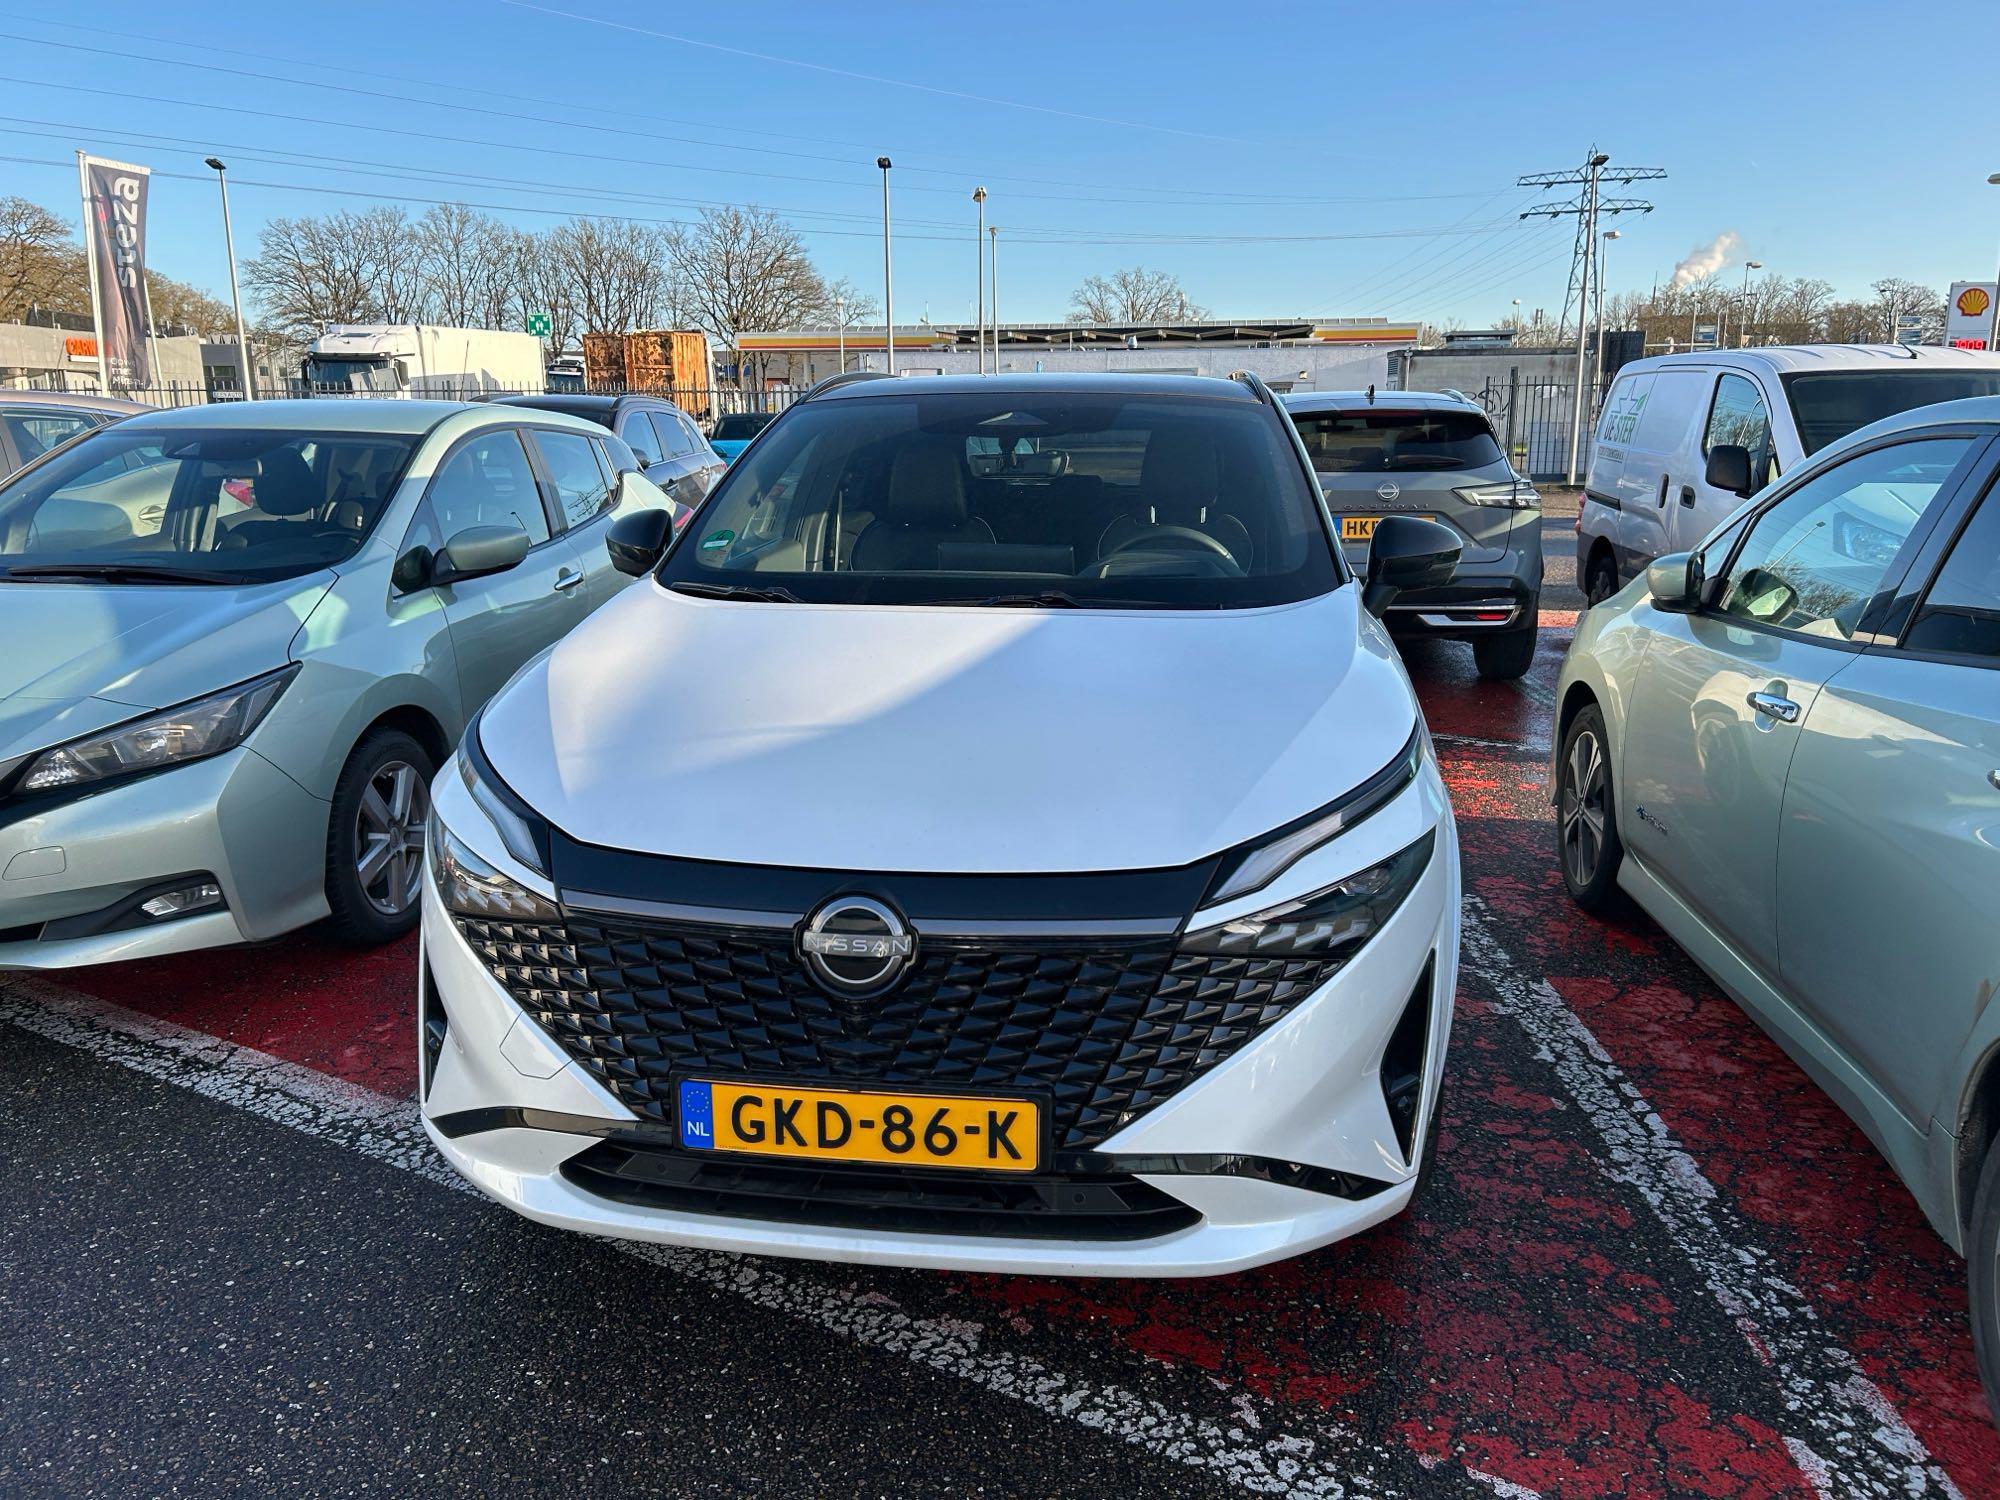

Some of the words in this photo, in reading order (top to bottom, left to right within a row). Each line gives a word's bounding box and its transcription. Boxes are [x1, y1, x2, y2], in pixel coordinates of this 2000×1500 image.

[805, 938, 909, 953] NISSAN
[687, 1120, 710, 1137] NL
[731, 1094, 1022, 1160] GKD-86-K
